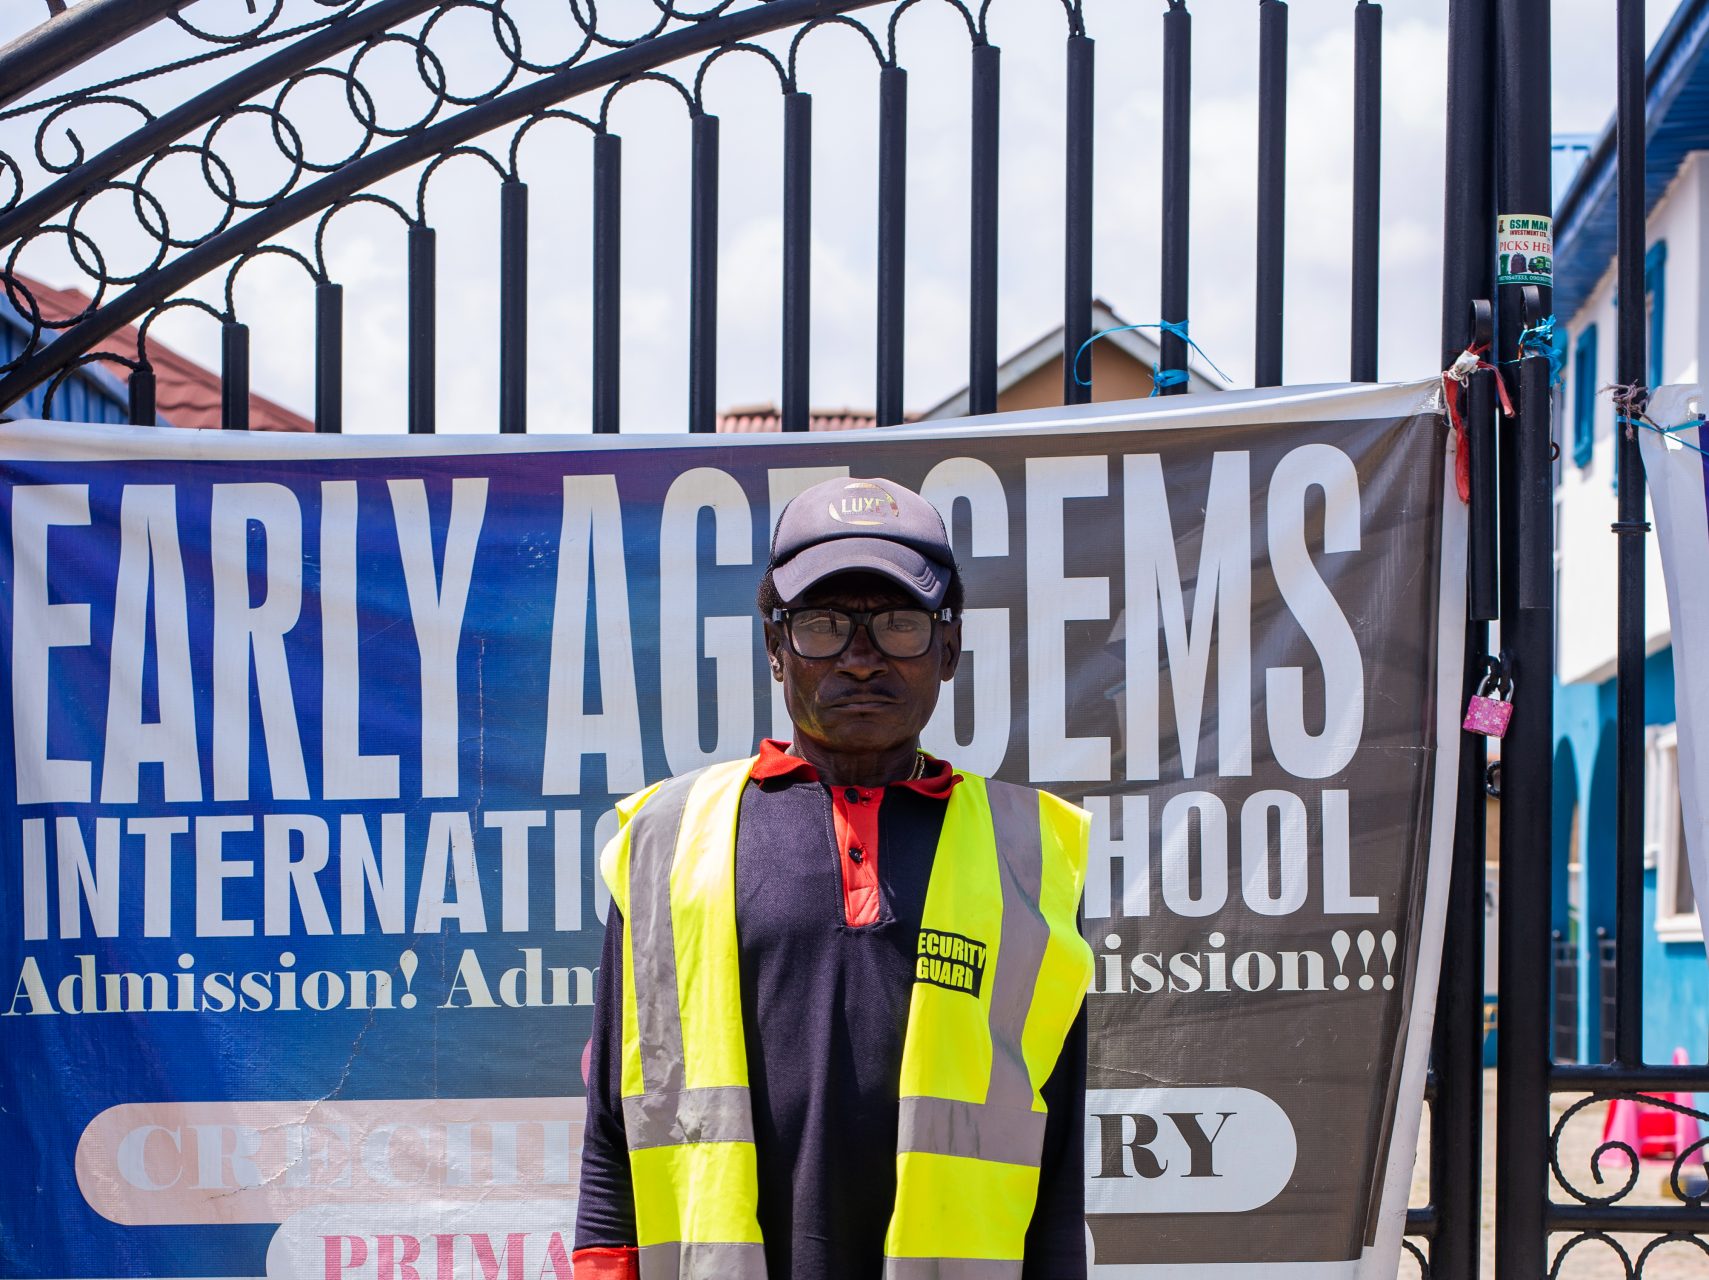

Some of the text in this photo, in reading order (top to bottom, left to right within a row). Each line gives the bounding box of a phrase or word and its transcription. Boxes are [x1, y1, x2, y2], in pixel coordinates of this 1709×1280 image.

[1509, 219, 1549, 232] GSM MAN
[1499, 240, 1530, 252] PICKS
[11, 476, 489, 804] EARLY
[919, 443, 1365, 784] GEMS
[1, 948, 419, 1016] Admission!
[1087, 929, 1397, 994] ission!!!
[916, 956, 974, 990] GUARD
